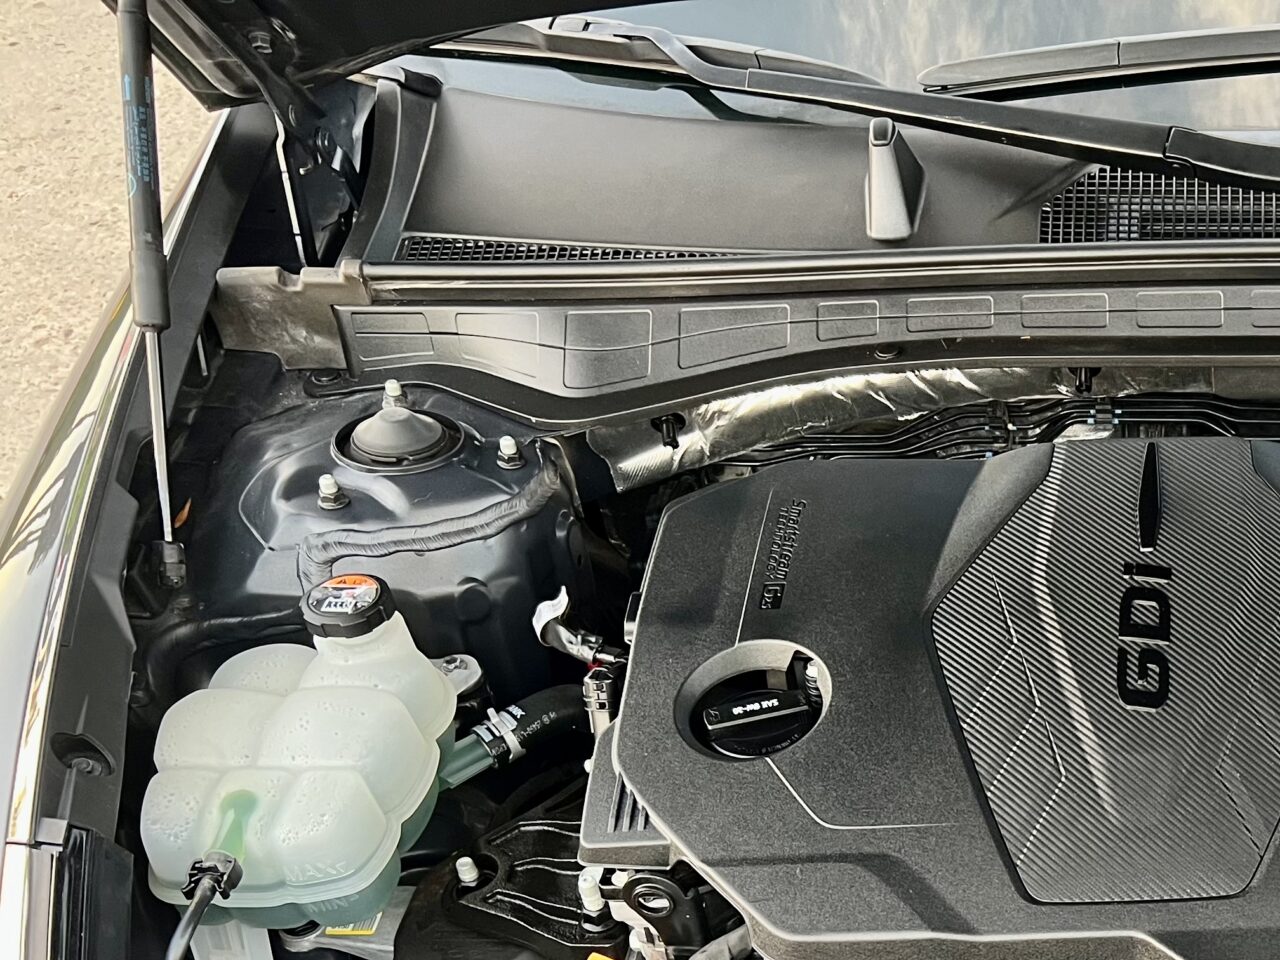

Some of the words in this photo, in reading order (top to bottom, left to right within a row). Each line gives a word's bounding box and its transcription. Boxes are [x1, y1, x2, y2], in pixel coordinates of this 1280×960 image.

[765, 507, 789, 580] TECHNOLOGY
[776, 499, 807, 580] Smartstream
[761, 698, 780, 709] SAE
